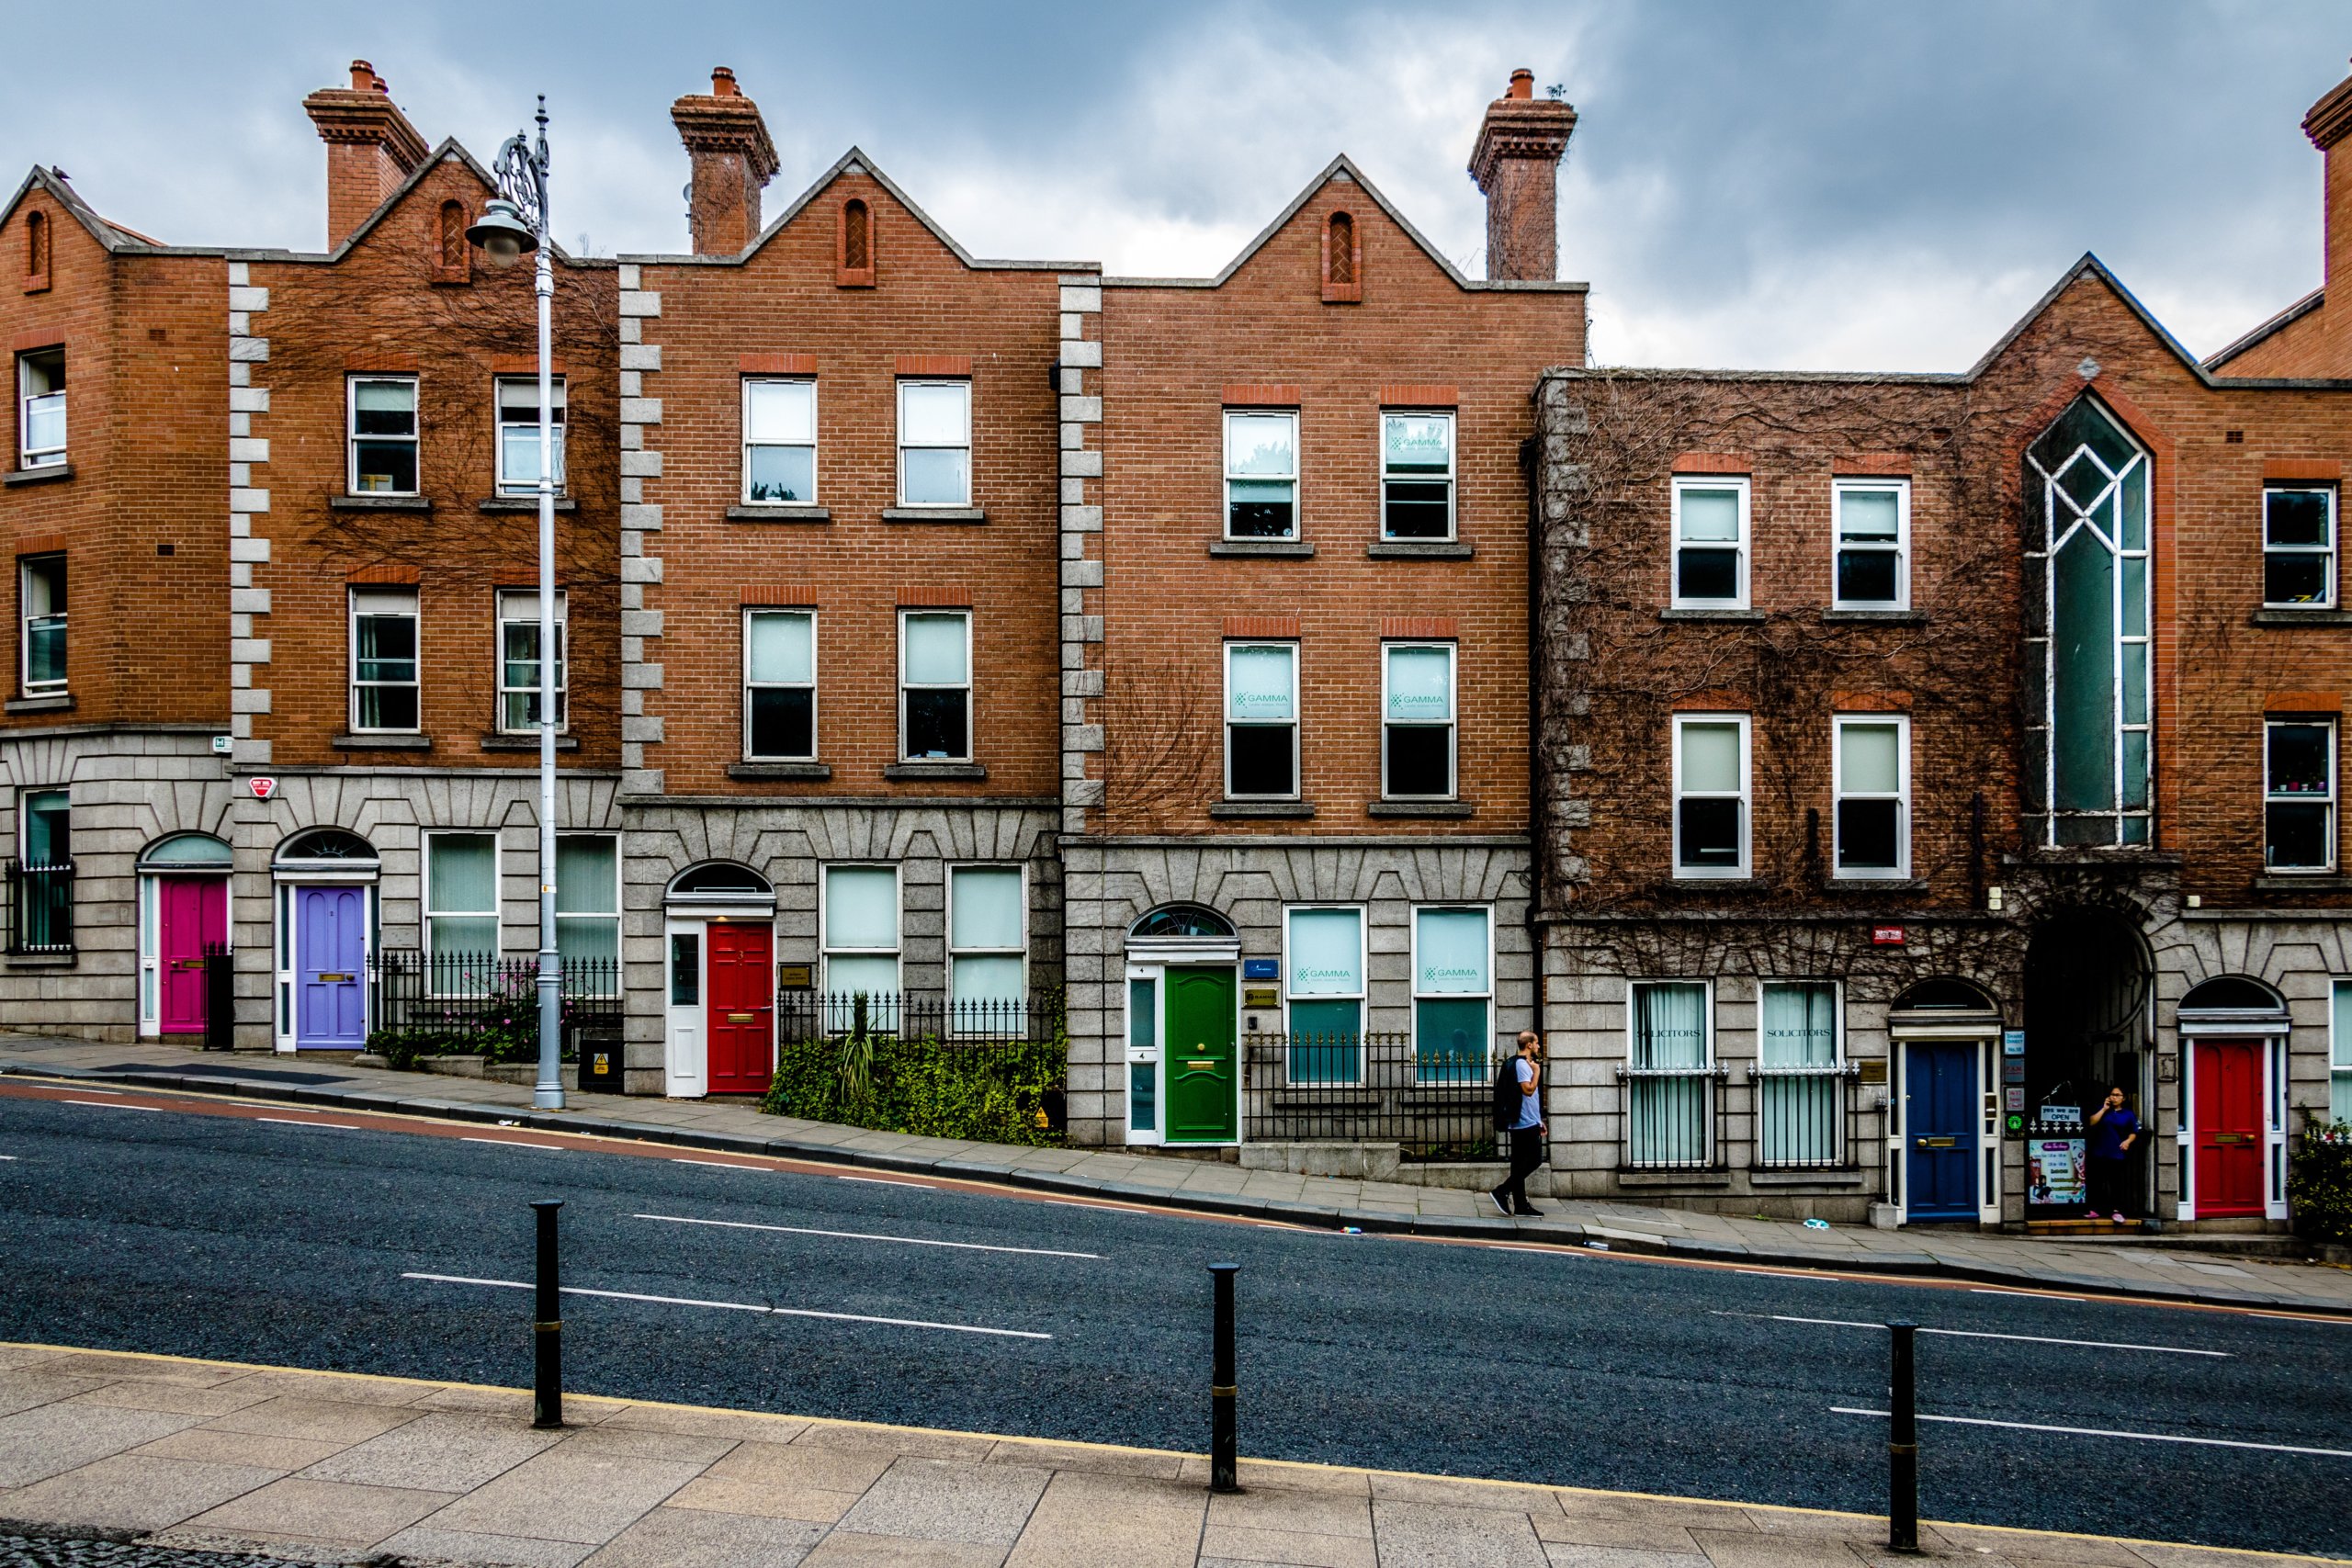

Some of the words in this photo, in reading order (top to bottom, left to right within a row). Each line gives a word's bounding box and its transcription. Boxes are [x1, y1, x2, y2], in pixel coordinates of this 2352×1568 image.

[1403, 695, 1443, 704] GAMMA
[737, 950, 744, 960] 3
[1767, 1029, 1831, 1038] SOLICITORS
